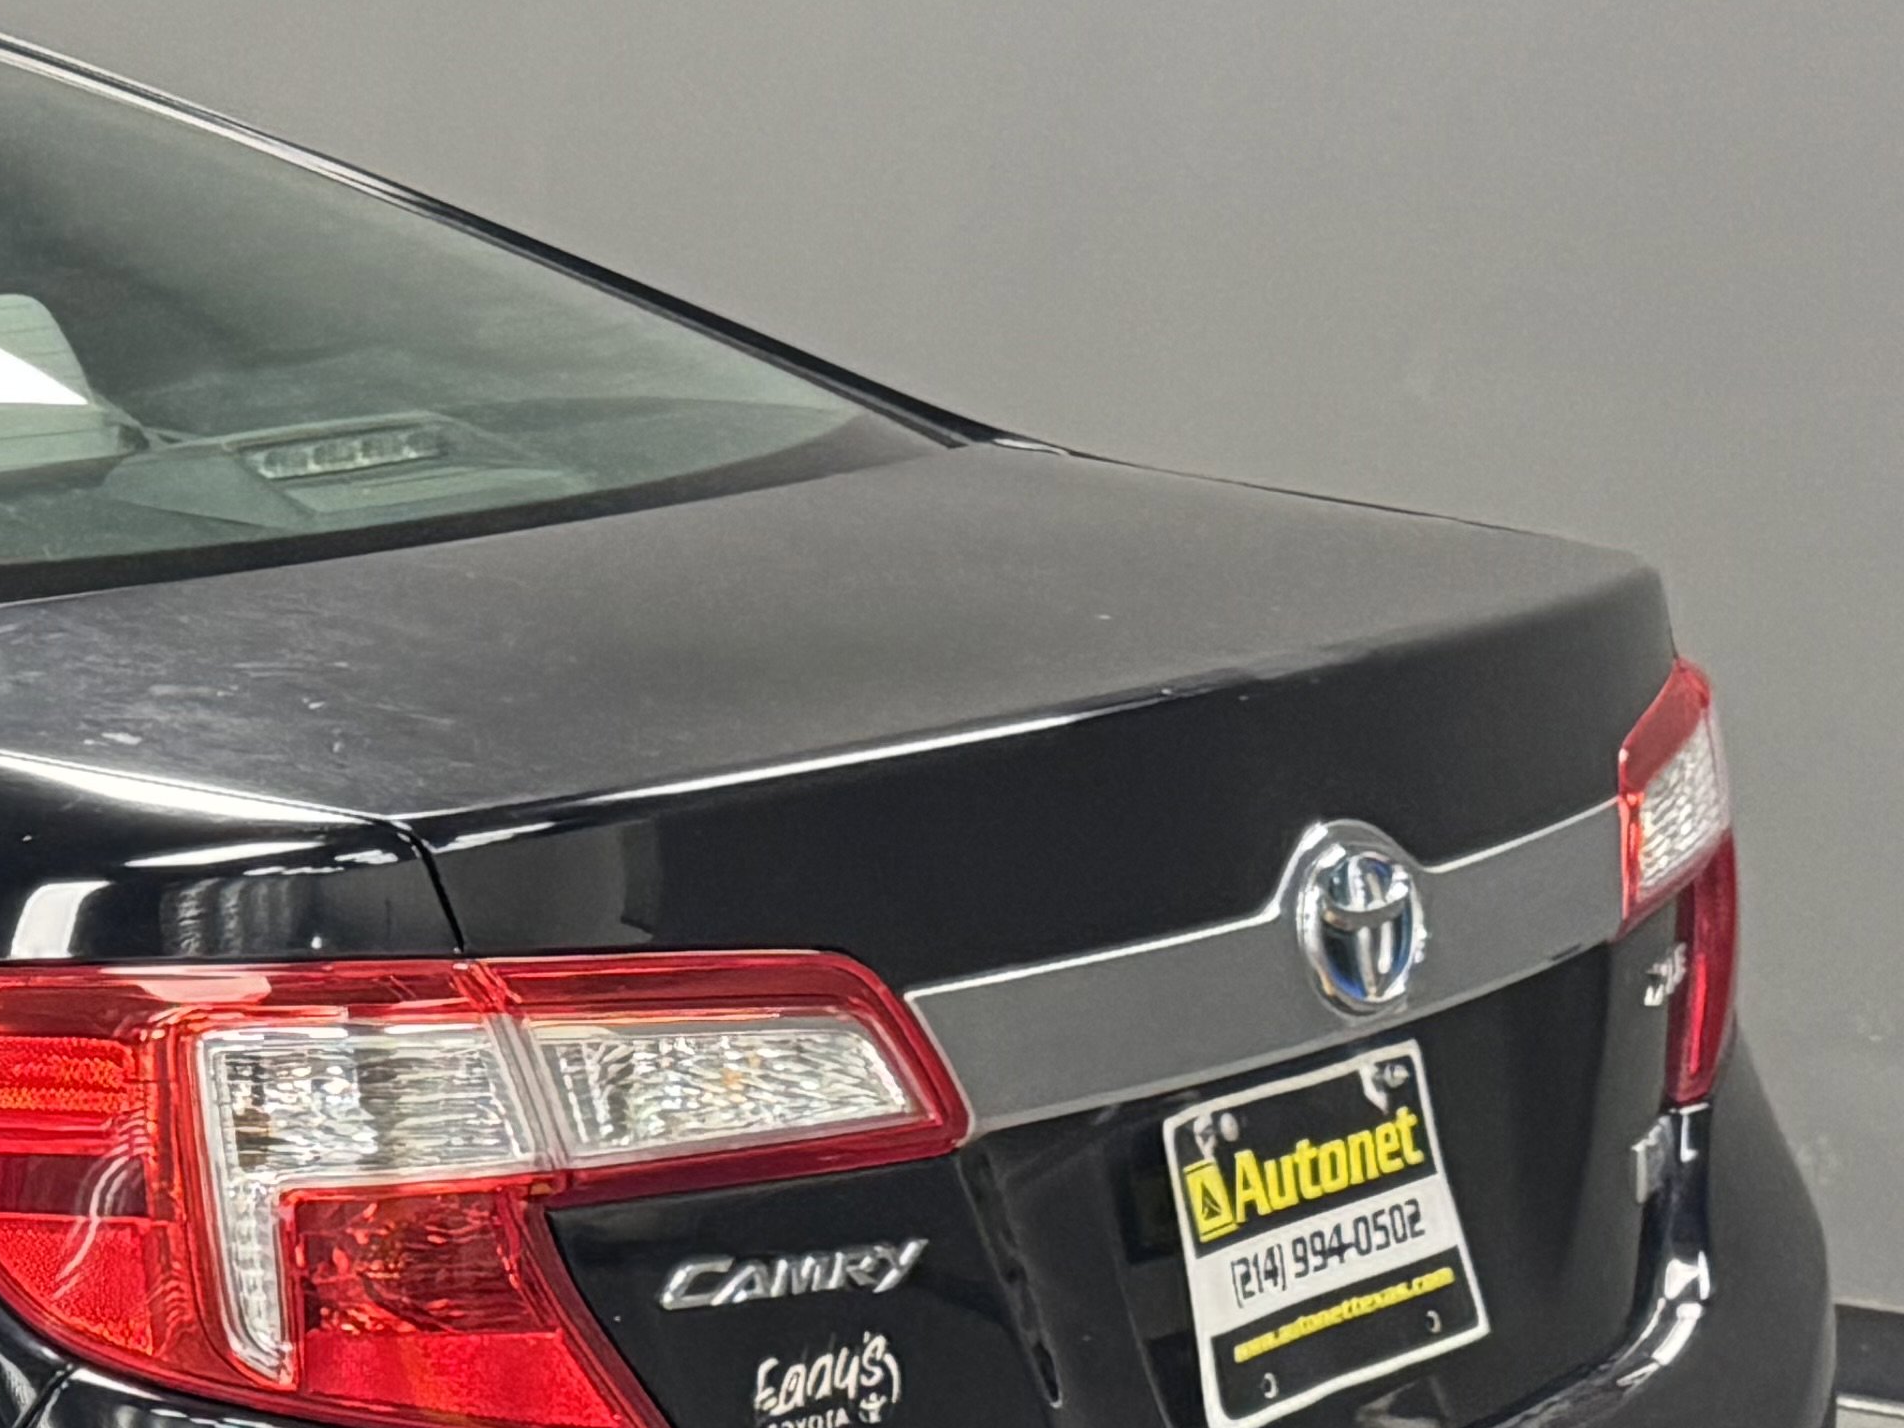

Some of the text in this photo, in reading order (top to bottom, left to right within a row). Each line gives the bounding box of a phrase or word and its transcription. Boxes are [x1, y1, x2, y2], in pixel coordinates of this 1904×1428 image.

[1234, 1105, 1425, 1224] Autonet
[660, 1238, 930, 1311] CAMRY
[1230, 1198, 1426, 1310] (214) 994-0502
